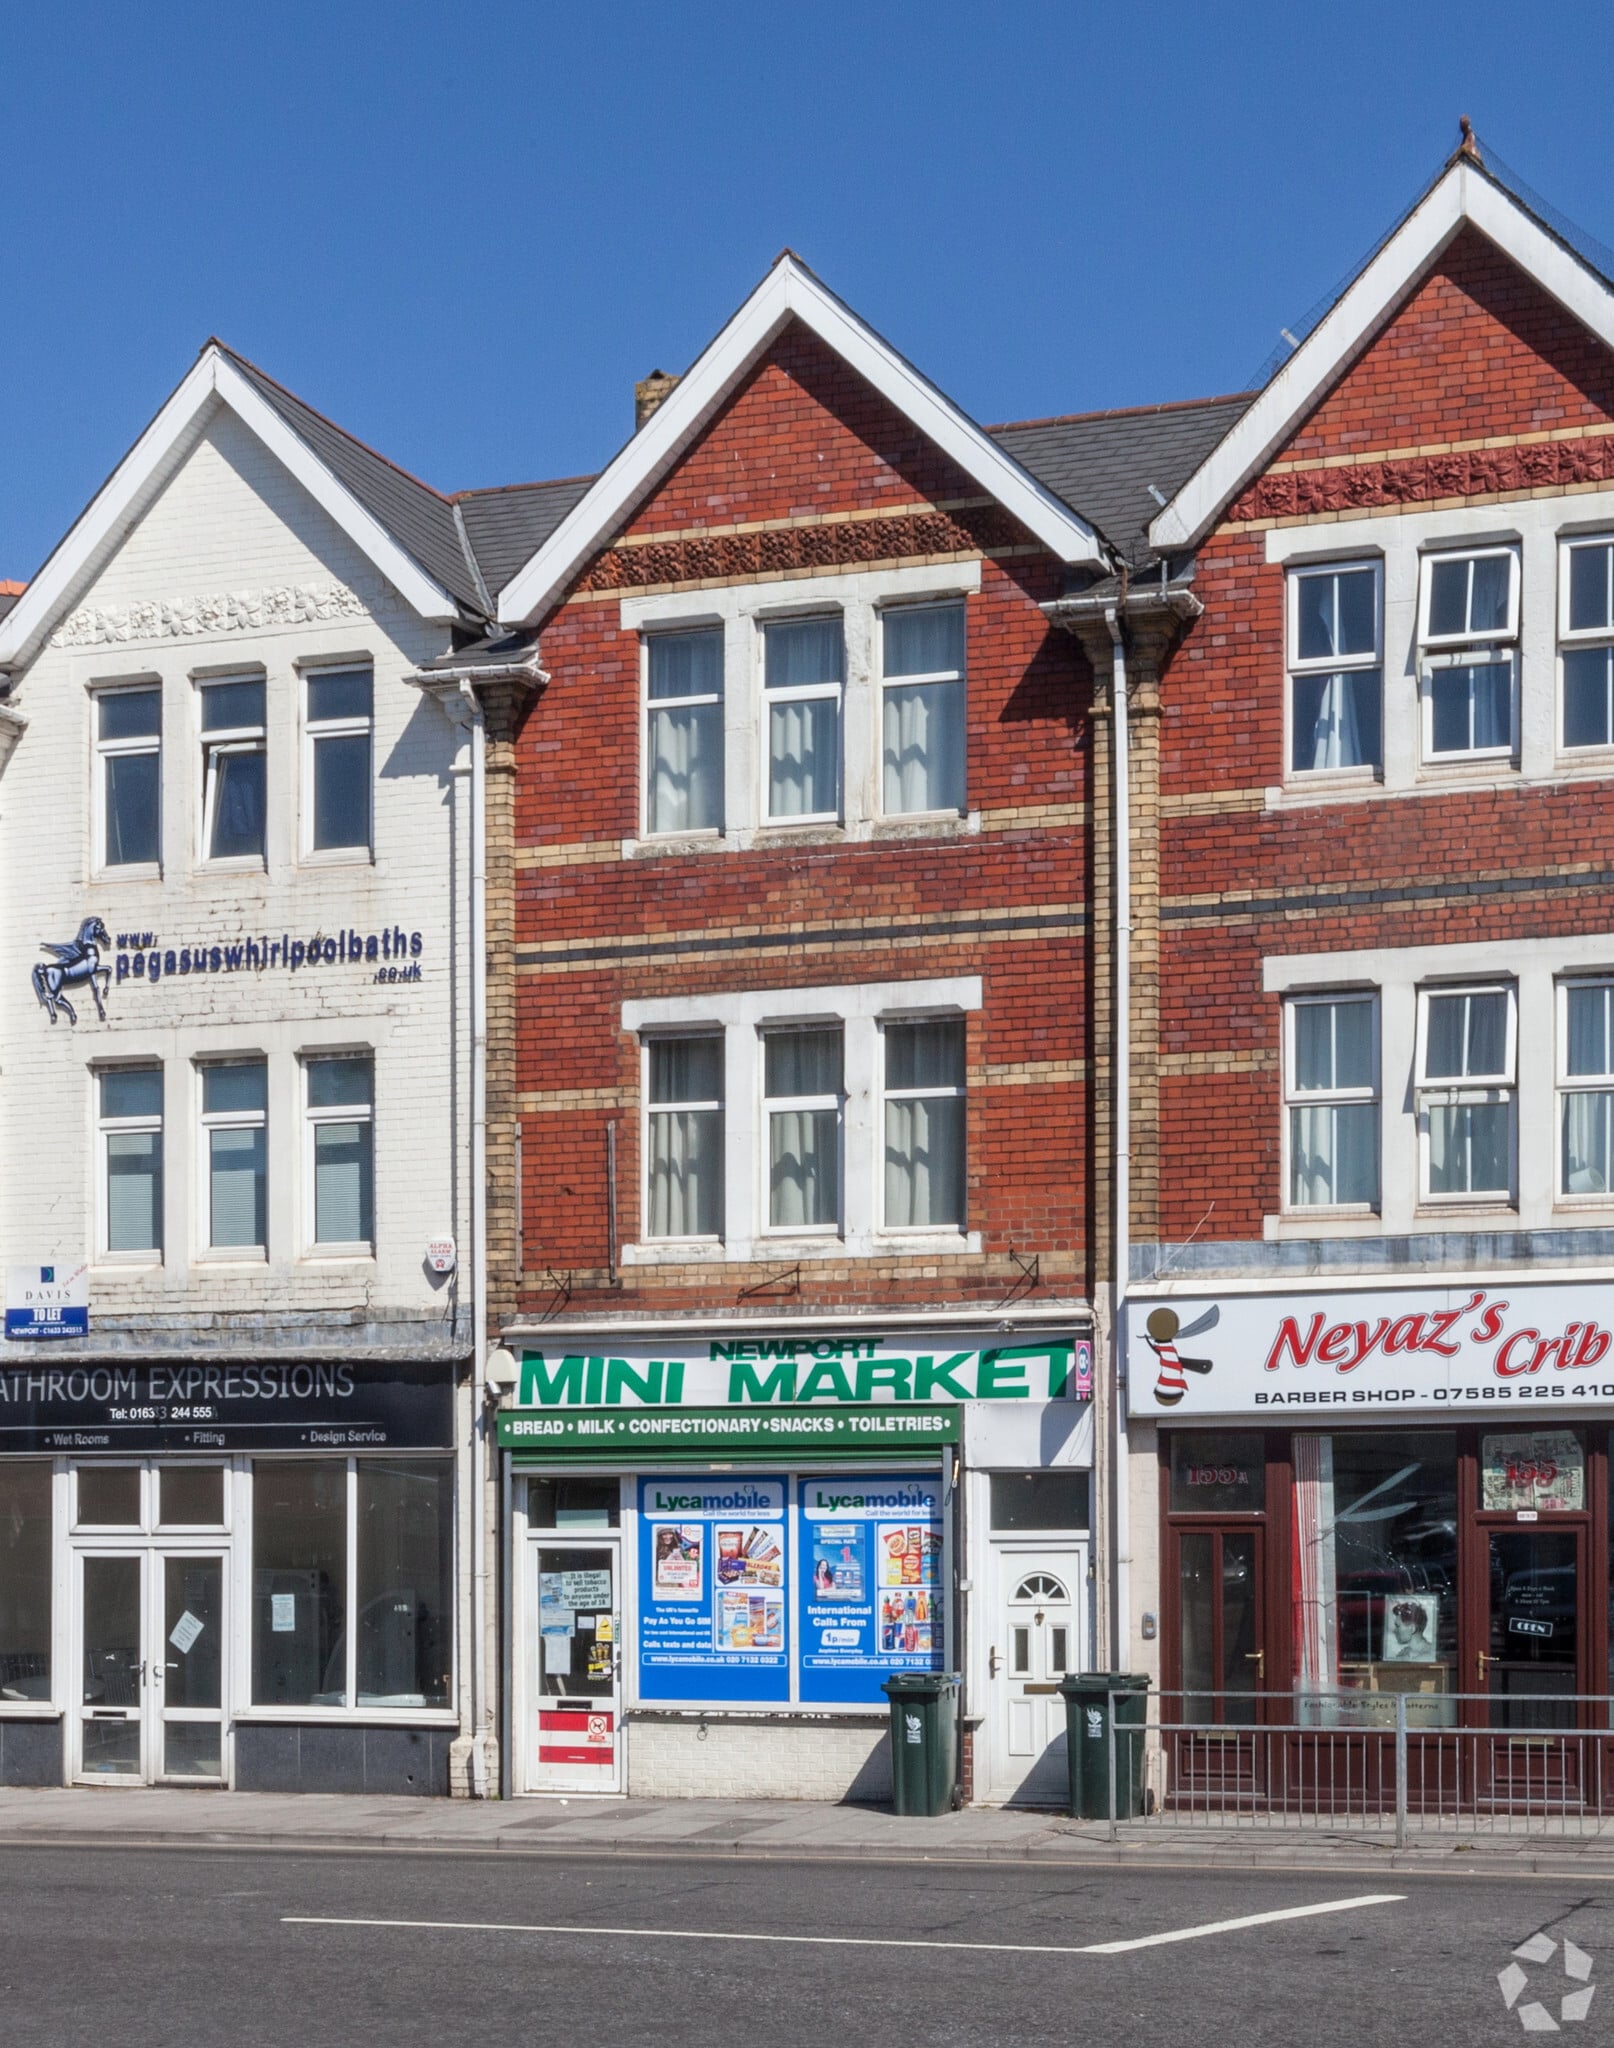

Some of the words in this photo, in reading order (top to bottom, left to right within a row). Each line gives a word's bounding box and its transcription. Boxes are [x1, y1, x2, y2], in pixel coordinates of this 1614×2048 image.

[116, 926, 423, 982] pegasuswhirlpoolbaths
[374, 961, 422, 984] .co.uk
[25, 1290, 71, 1300] DAVIS
[33, 1308, 46, 1321] TO
[46, 1308, 63, 1321] LET
[1264, 1290, 1508, 1374] Neyaz's
[710, 1338, 884, 1362] NEWPORT
[1493, 1322, 1613, 1379] Crib
[519, 1349, 686, 1405] MINI
[728, 1338, 1077, 1403] MARKET
[149, 1364, 355, 1400] EXPRESSIONS
[1254, 1391, 1347, 1404] BARBER
[1351, 1389, 1416, 1402] SHOP
[1432, 1387, 1513, 1400] 07585
[1518, 1385, 1565, 1398] 225
[1572, 1384, 1614, 1397] 410
[109, 1408, 128, 1419] Tel:
[171, 1407, 191, 1419] 244
[193, 1406, 212, 1418] 555
[513, 1419, 564, 1435] BREAD
[577, 1419, 615, 1434] MILK
[629, 1418, 761, 1434] CONFECTIONARY
[770, 1417, 834, 1433] SNACKS
[848, 1416, 943, 1432] TOILETRIES
[53, 1433, 73, 1445] Wet
[74, 1433, 110, 1445] Rooms
[193, 1432, 226, 1445] Fitting
[310, 1430, 346, 1444] Design
[348, 1430, 387, 1442] Service
[1503, 1458, 1557, 1481] 155
[656, 1491, 771, 1512] Lycamobile
[816, 1490, 937, 1512] Lycamobile
[574, 1586, 599, 1594] products
[807, 1605, 872, 1615] International
[643, 1616, 658, 1626] Pay
[658, 1617, 669, 1625] As
[669, 1616, 684, 1625] You
[684, 1616, 696, 1625] Go
[813, 1617, 838, 1627] Calls
[840, 1617, 867, 1627] From
[1517, 1621, 1546, 1633] OPEN
[662, 1641, 681, 1649] texts
[681, 1641, 696, 1649] and
[696, 1641, 712, 1649] data
[726, 1656, 739, 1664] 020
[889, 1657, 904, 1666] 020
